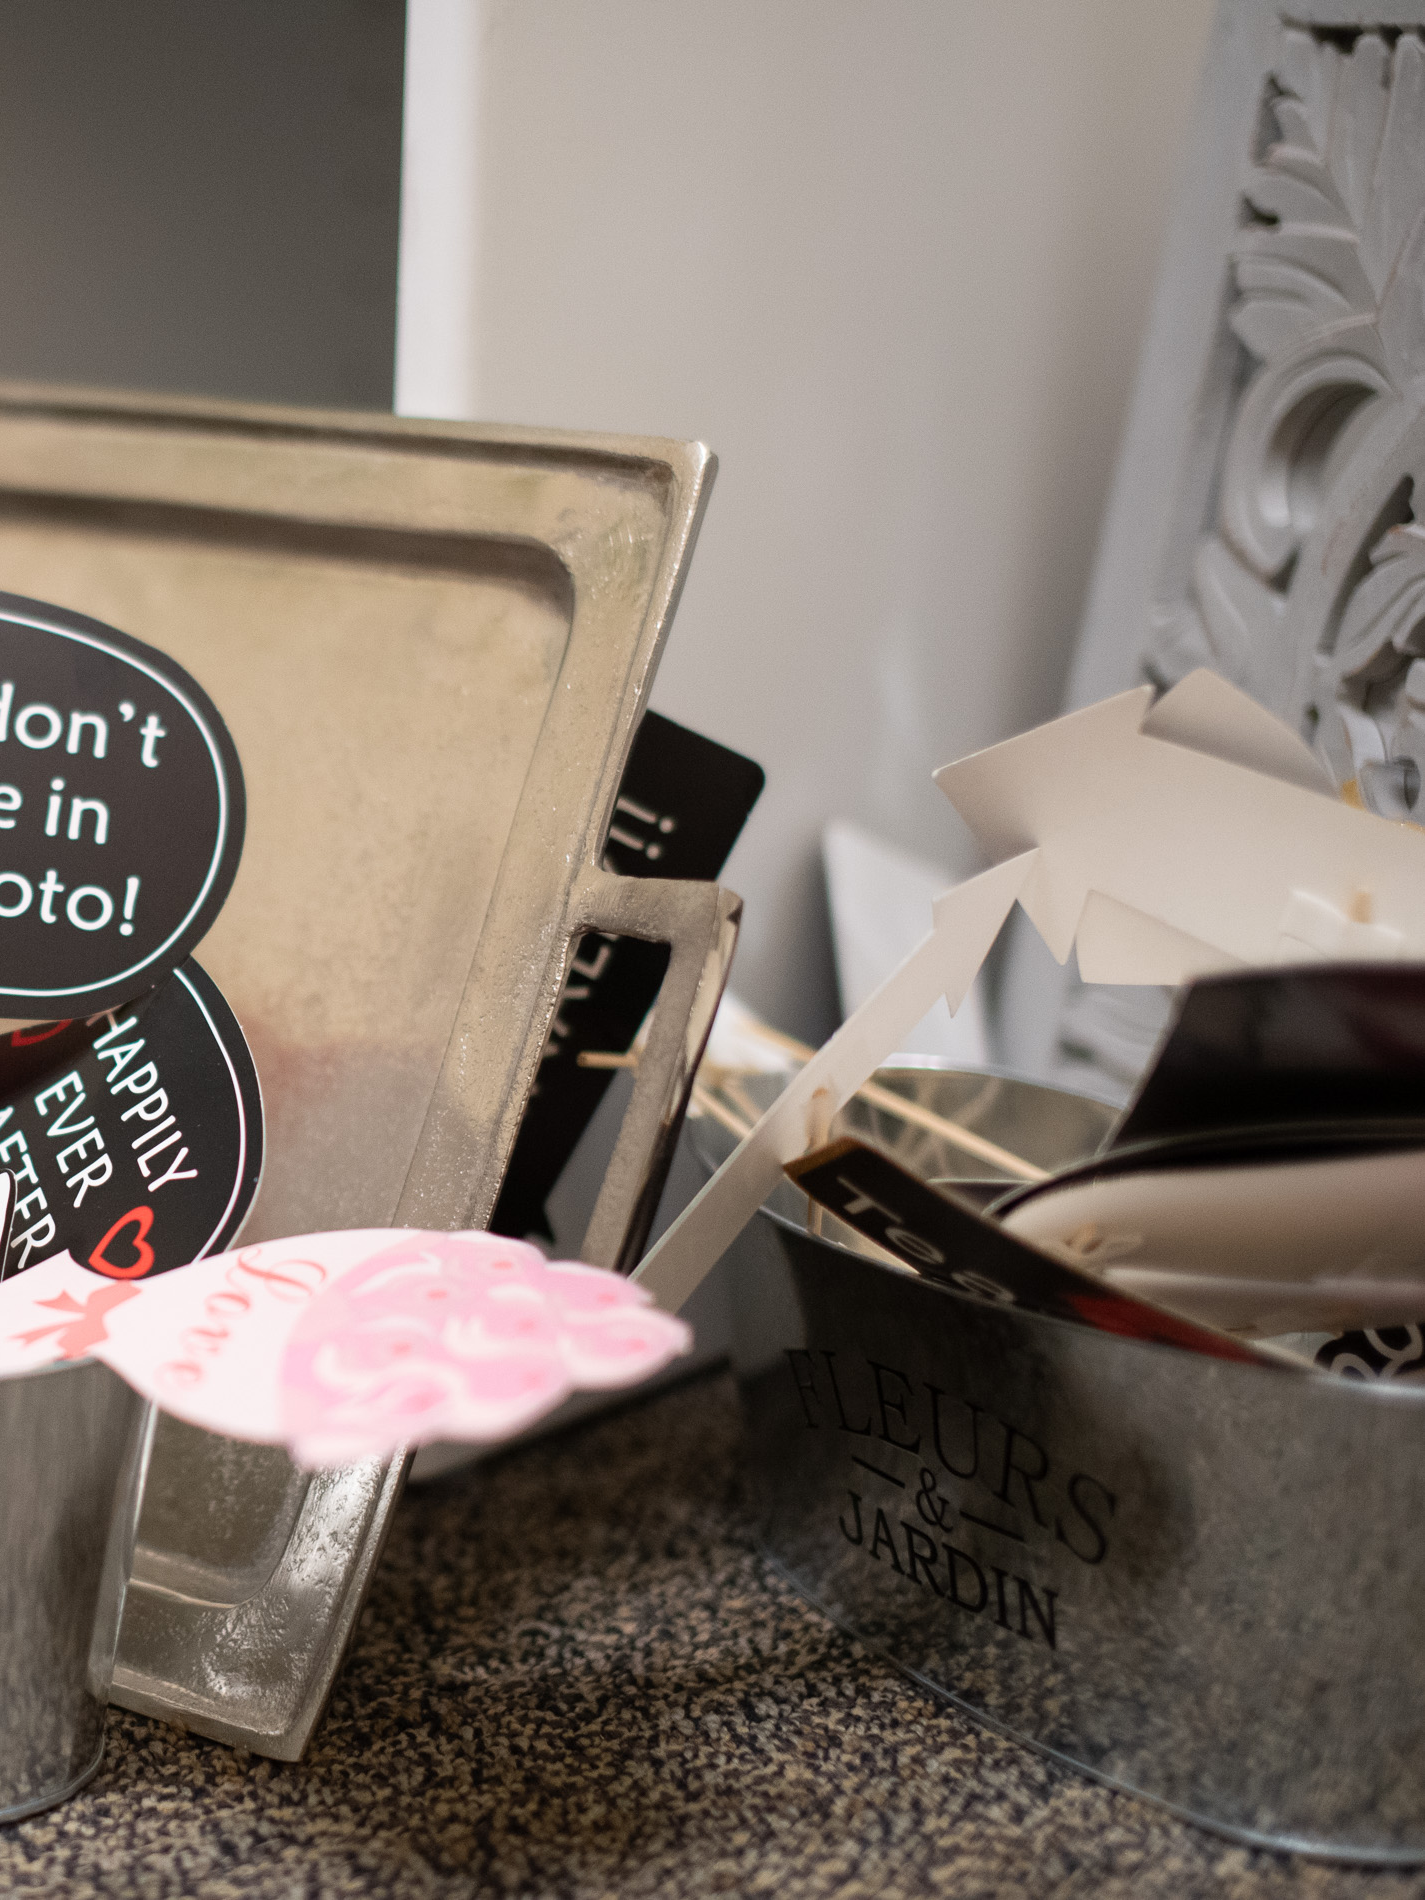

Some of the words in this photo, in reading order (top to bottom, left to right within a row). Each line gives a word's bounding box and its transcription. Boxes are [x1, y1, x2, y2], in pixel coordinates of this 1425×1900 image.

[43, 776, 109, 845] in
[34, 1069, 114, 1209] EVER
[85, 1003, 199, 1194] HAPPILY
[783, 1349, 1119, 1566] FLEURS
[915, 1466, 954, 1534] &
[838, 1488, 1059, 1651] JARDIN
